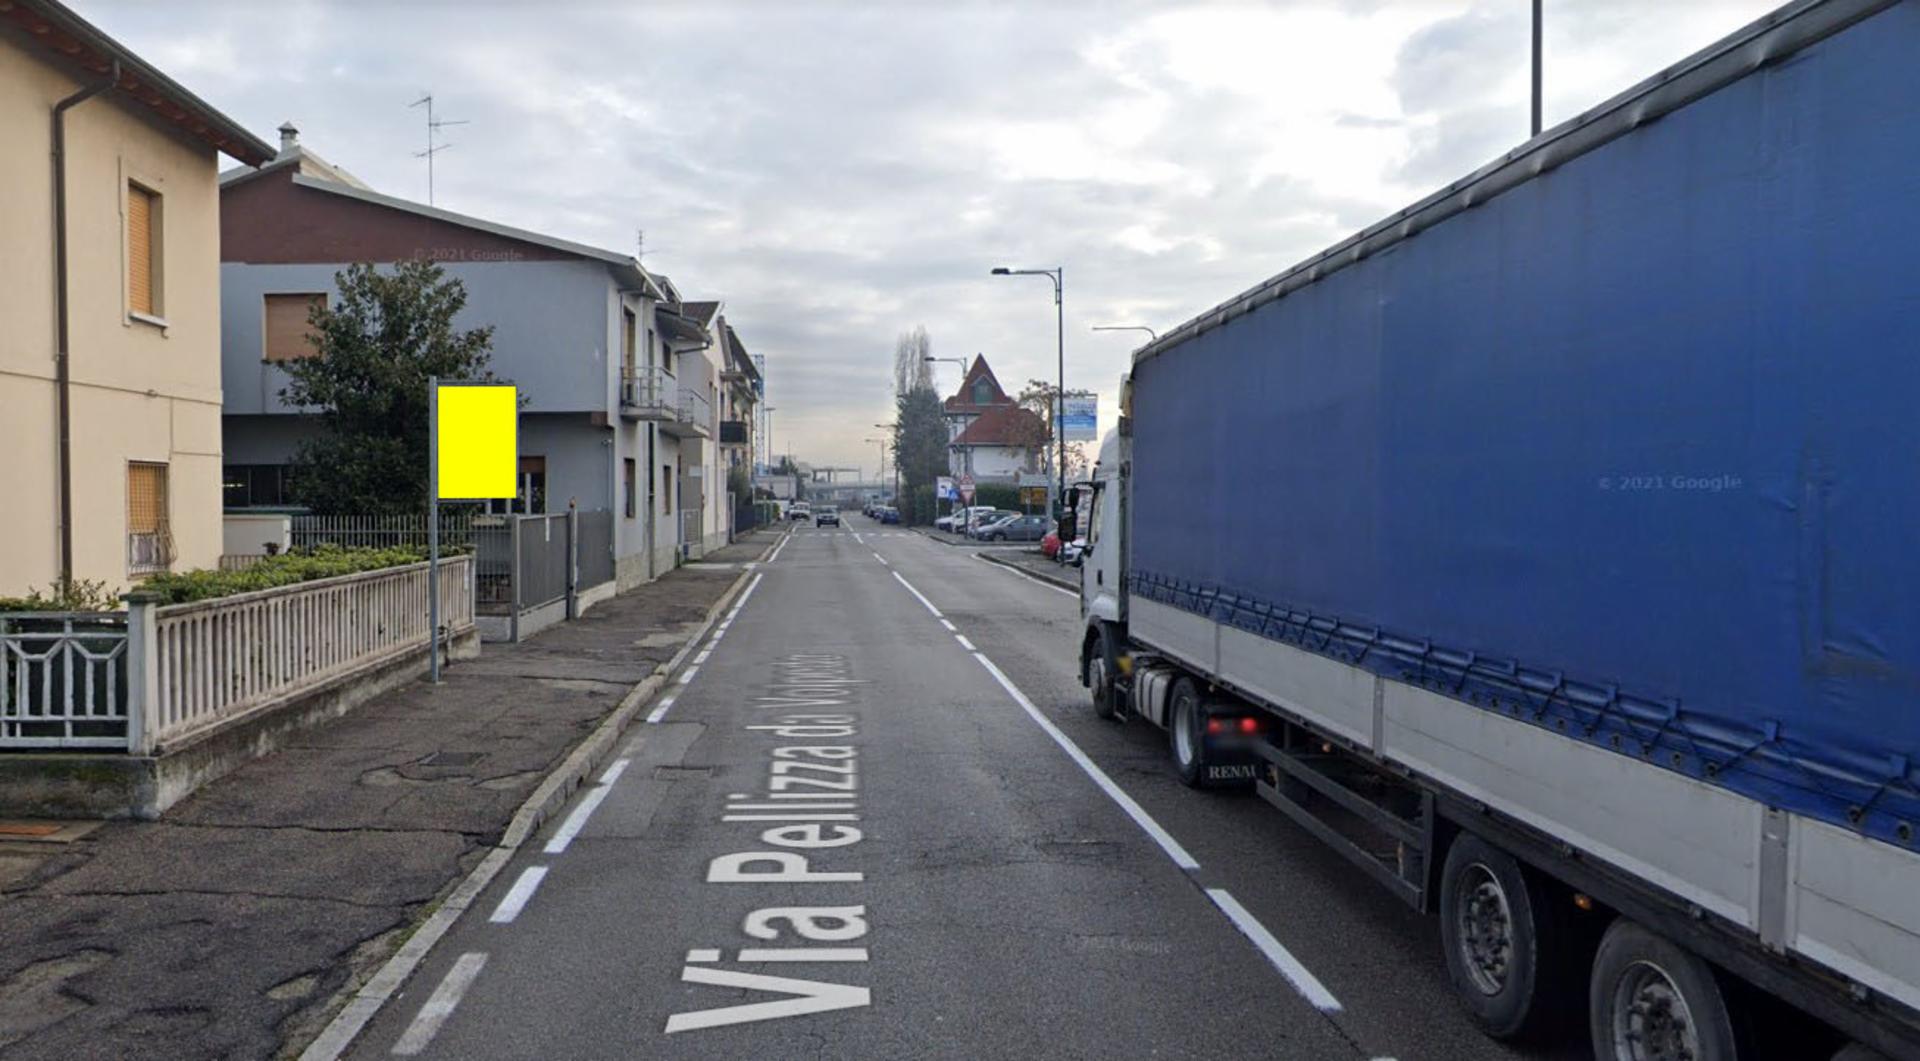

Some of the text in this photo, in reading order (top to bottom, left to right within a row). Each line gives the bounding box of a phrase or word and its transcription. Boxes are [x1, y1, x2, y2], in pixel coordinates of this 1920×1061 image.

[743, 713, 859, 738] da
[706, 745, 866, 883] Pellizza
[664, 905, 872, 1034] Via
